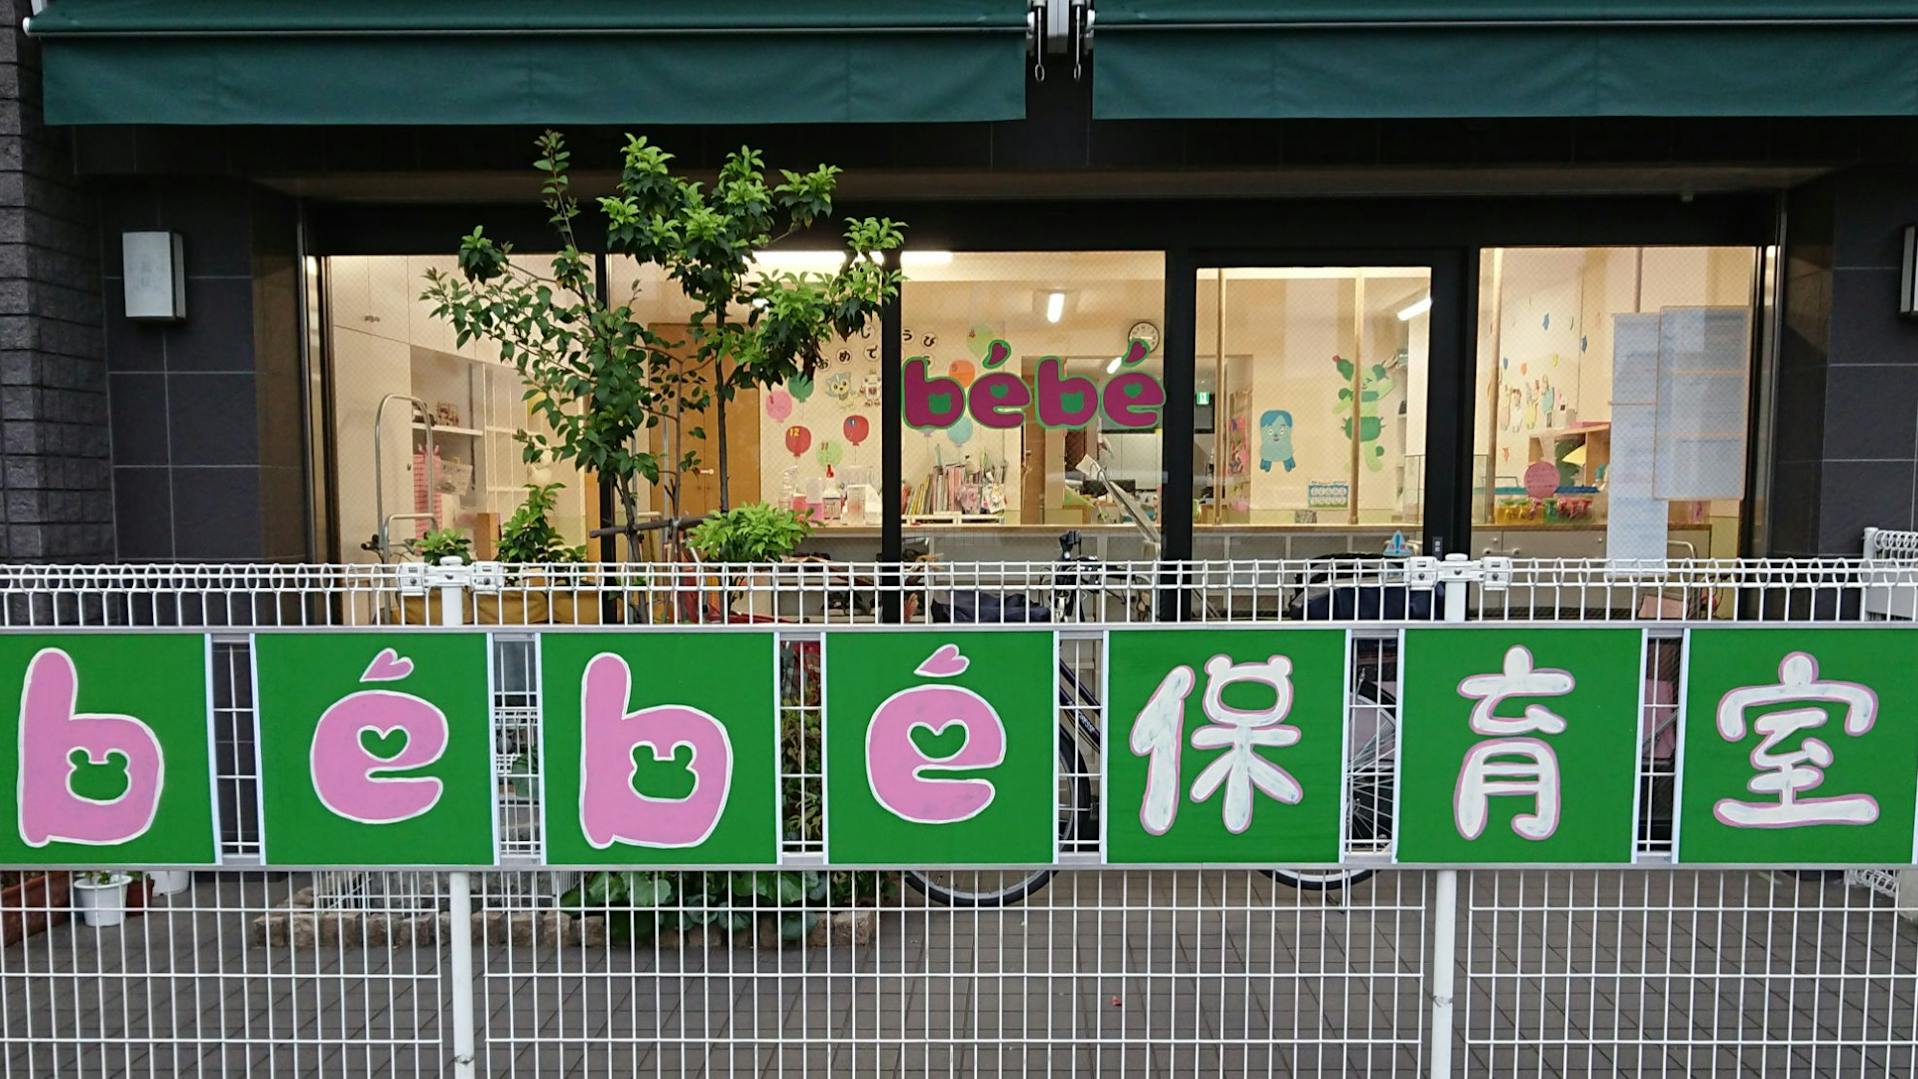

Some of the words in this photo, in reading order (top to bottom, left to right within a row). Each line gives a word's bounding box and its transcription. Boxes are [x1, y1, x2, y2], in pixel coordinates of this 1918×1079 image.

[902, 339, 1167, 430] bébé
[788, 427, 801, 438] 12
[17, 644, 1007, 850] bébé
[1129, 644, 1880, 842] 保育室
